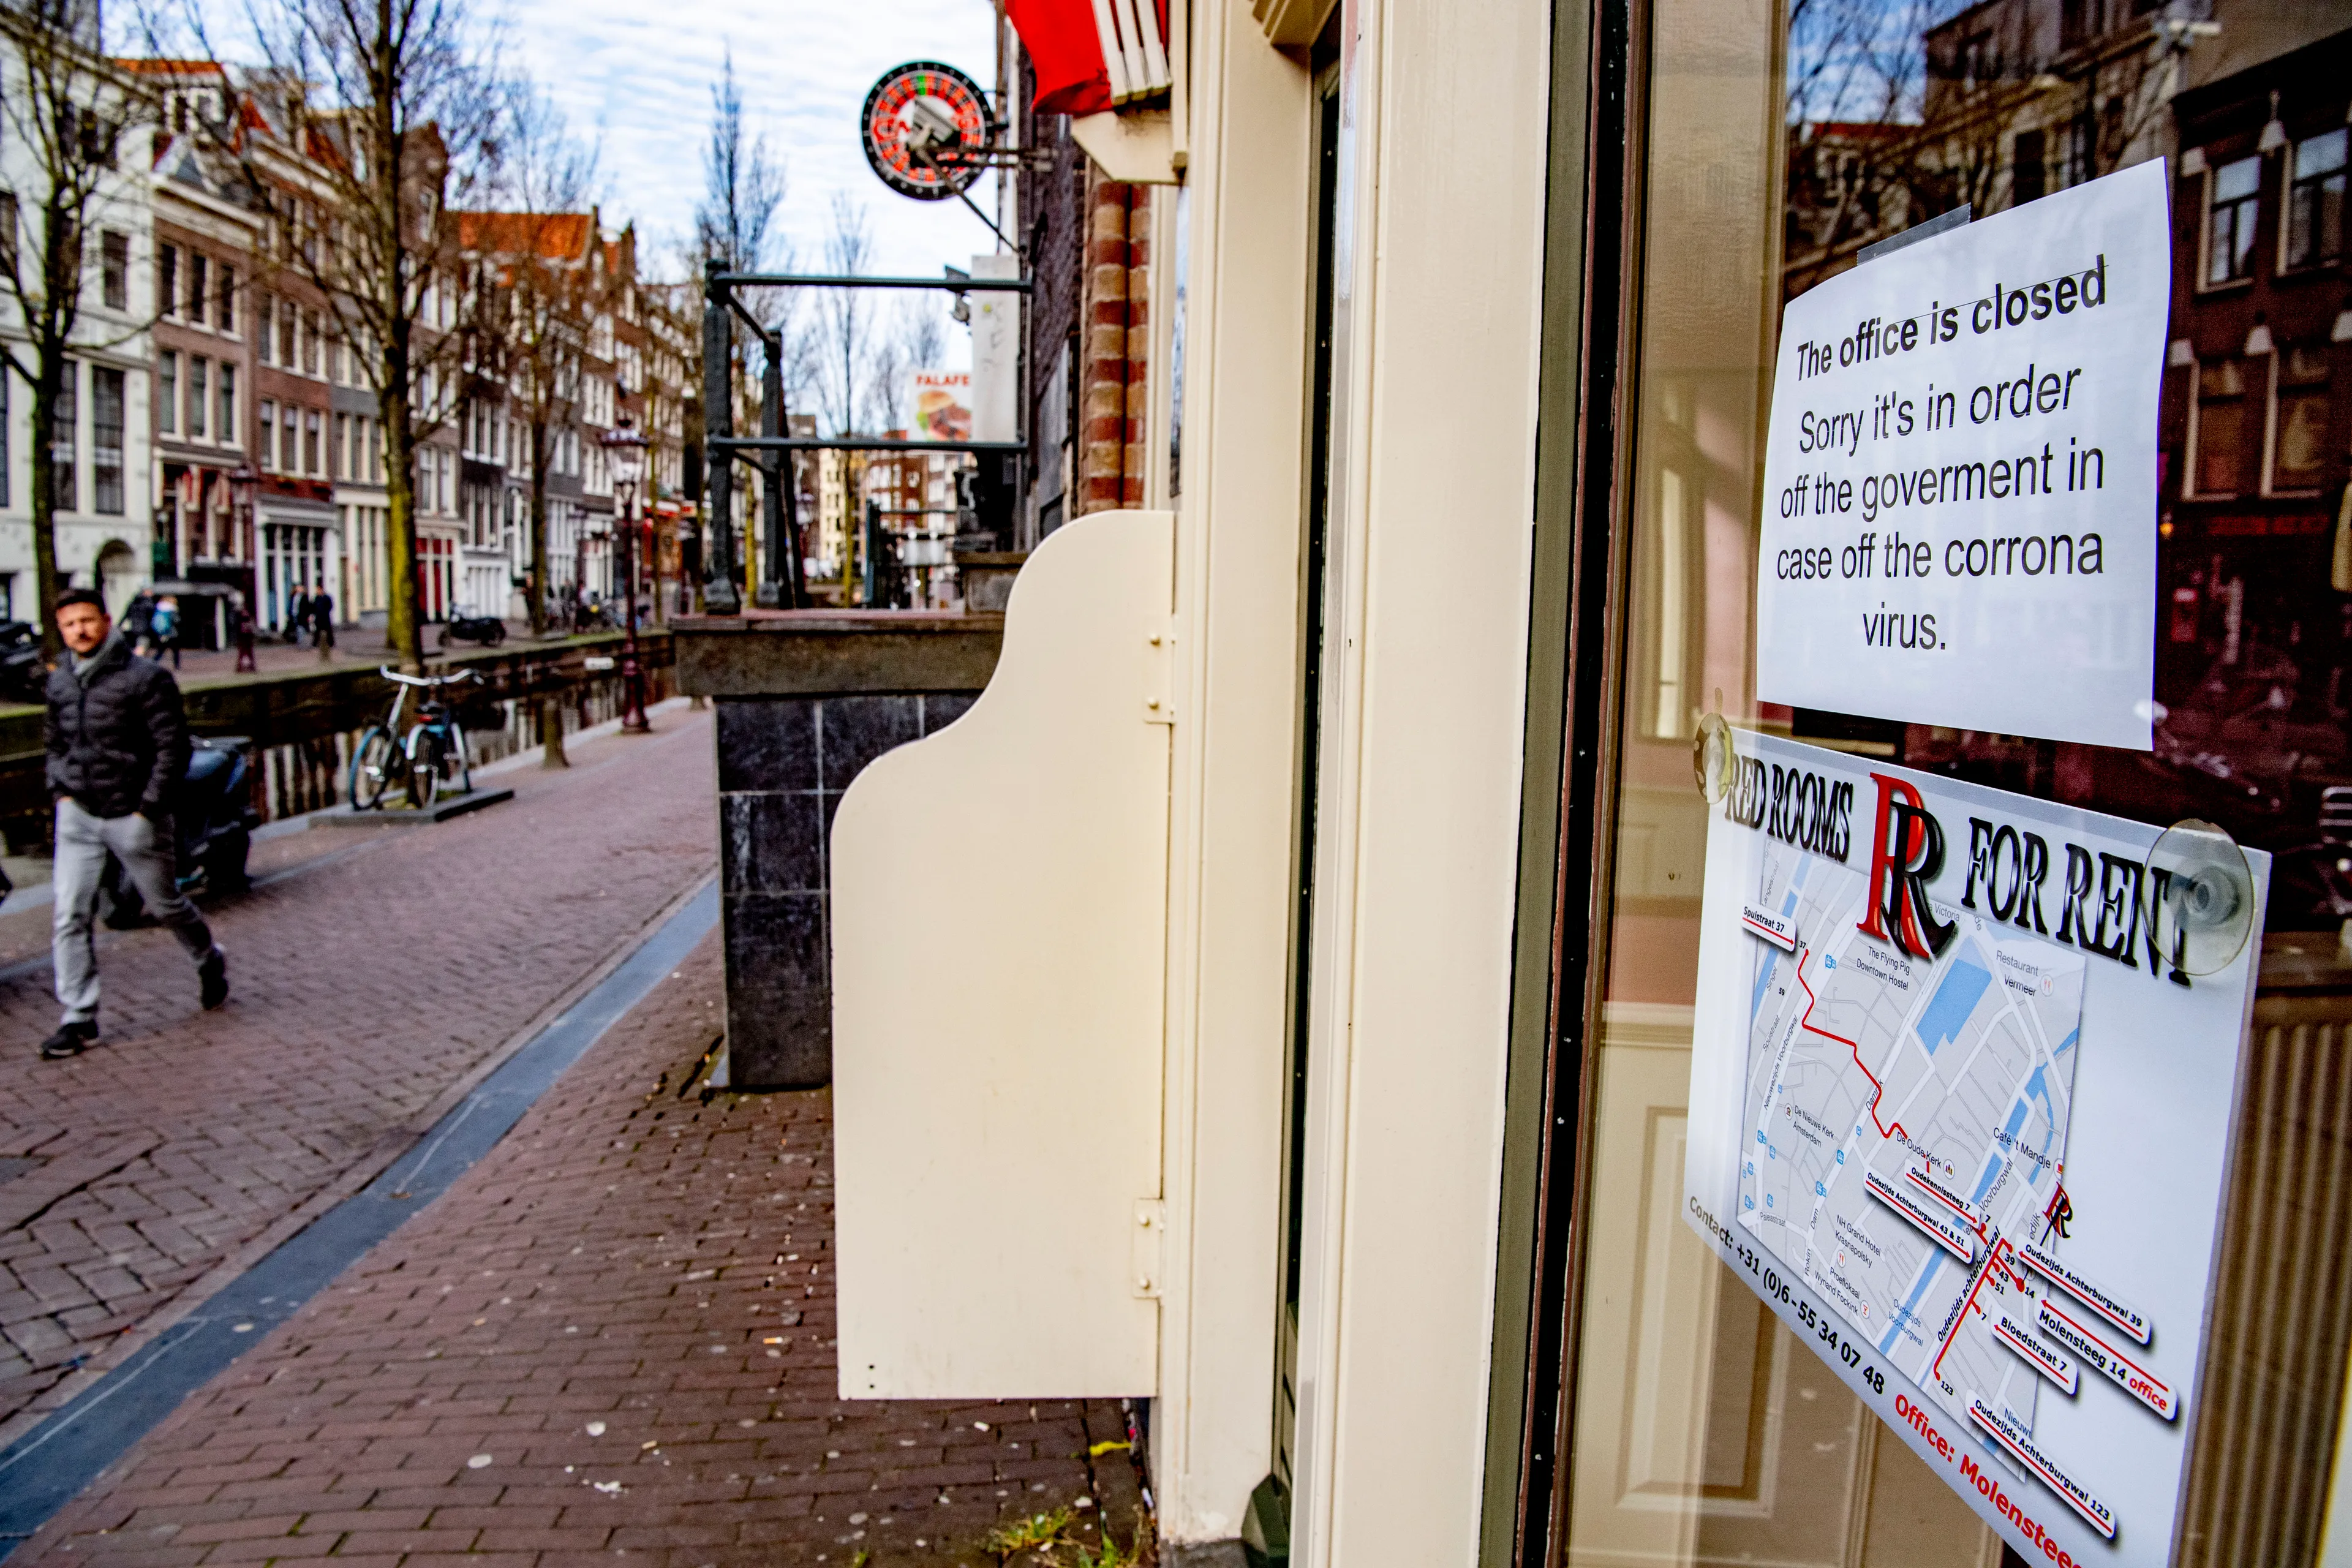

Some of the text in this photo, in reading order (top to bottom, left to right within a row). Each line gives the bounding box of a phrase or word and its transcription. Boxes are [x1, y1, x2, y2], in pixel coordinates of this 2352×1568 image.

[1796, 254, 2106, 382] The office is closed
[1799, 364, 2081, 457] Sorry it's in order
[1781, 437, 2104, 522] off the goverment in
[1777, 531, 2104, 580] case off the corrona
[1863, 601, 1946, 650] virus.
[1724, 753, 1766, 829] RED
[1767, 764, 1853, 863] ROOMS
[1961, 816, 2048, 935] FOR
[1743, 907, 1785, 933] Spuistraat 37
[1935, 903, 1960, 922] Victoria
[1766, 965, 1777, 992] Singel
[1856, 959, 1909, 992] Downtown Hostel
[1868, 946, 1910, 976] The Flying Pig
[1996, 950, 2039, 977] Restaurant
[1778, 987, 1785, 996] 59
[2004, 974, 2037, 997] Vermeer
[1763, 1014, 1781, 1052] Spuistraat
[1763, 1014, 1799, 1110] Nieuwezijds Voorburgwal
[1865, 1079, 1883, 1111] Damrk
[1793, 1121, 1822, 1148] Amsterdam
[1794, 1105, 1835, 1140] De Nieuwe Kerk
[1896, 1132, 1942, 1169] De Oude Kerk
[1993, 1127, 2011, 1146] Café
[2021, 1142, 2051, 1169] Mandje
[1911, 1166, 1964, 1209] Oudekennissteeg
[1978, 1157, 2013, 1212] Voorburgwal
[1760, 1212, 1786, 1227] Paleisstraat
[1810, 1208, 1819, 1231] Dam
[1867, 1172, 1964, 1246] Oudezijds Achterburgwal 43 & 51
[1985, 1215, 1991, 1223] 7
[1835, 1230, 1872, 1268] Krasnapolsky
[1836, 1214, 1881, 1257] NH Grand Hotel
[1999, 1271, 2009, 1282] 43
[2005, 1253, 2015, 1265] 39
[1815, 1270, 1858, 1316] Wynand Fockink
[1830, 1267, 1860, 1299] Proeflokaal
[1937, 1226, 2000, 1342] Oudezijds achterburgwal
[1995, 1283, 2004, 1295] 51
[2024, 1287, 2035, 1298] 14
[2025, 1243, 2143, 1327] Oudezijds Achterburgwal 39
[1888, 1311, 1924, 1348] Voorburgwal
[1893, 1298, 1921, 1328] Oudezijds
[2000, 1317, 2068, 1372] Bloedstraat 7
[2039, 1310, 2168, 1411] Molensteeg 14 office
[1689, 1196, 1734, 1250] Contact:
[1737, 1243, 1760, 1276] +31
[1818, 1320, 1838, 1350] 34
[1841, 1341, 1861, 1368] 07
[1863, 1365, 1885, 1395] 48
[1894, 1393, 1955, 1463] Office:
[1959, 1453, 2083, 1568] Molenstee
[1940, 1380, 1954, 1396] 123
[1975, 1400, 2110, 1521] Oudezijds Achterburgwal 123
